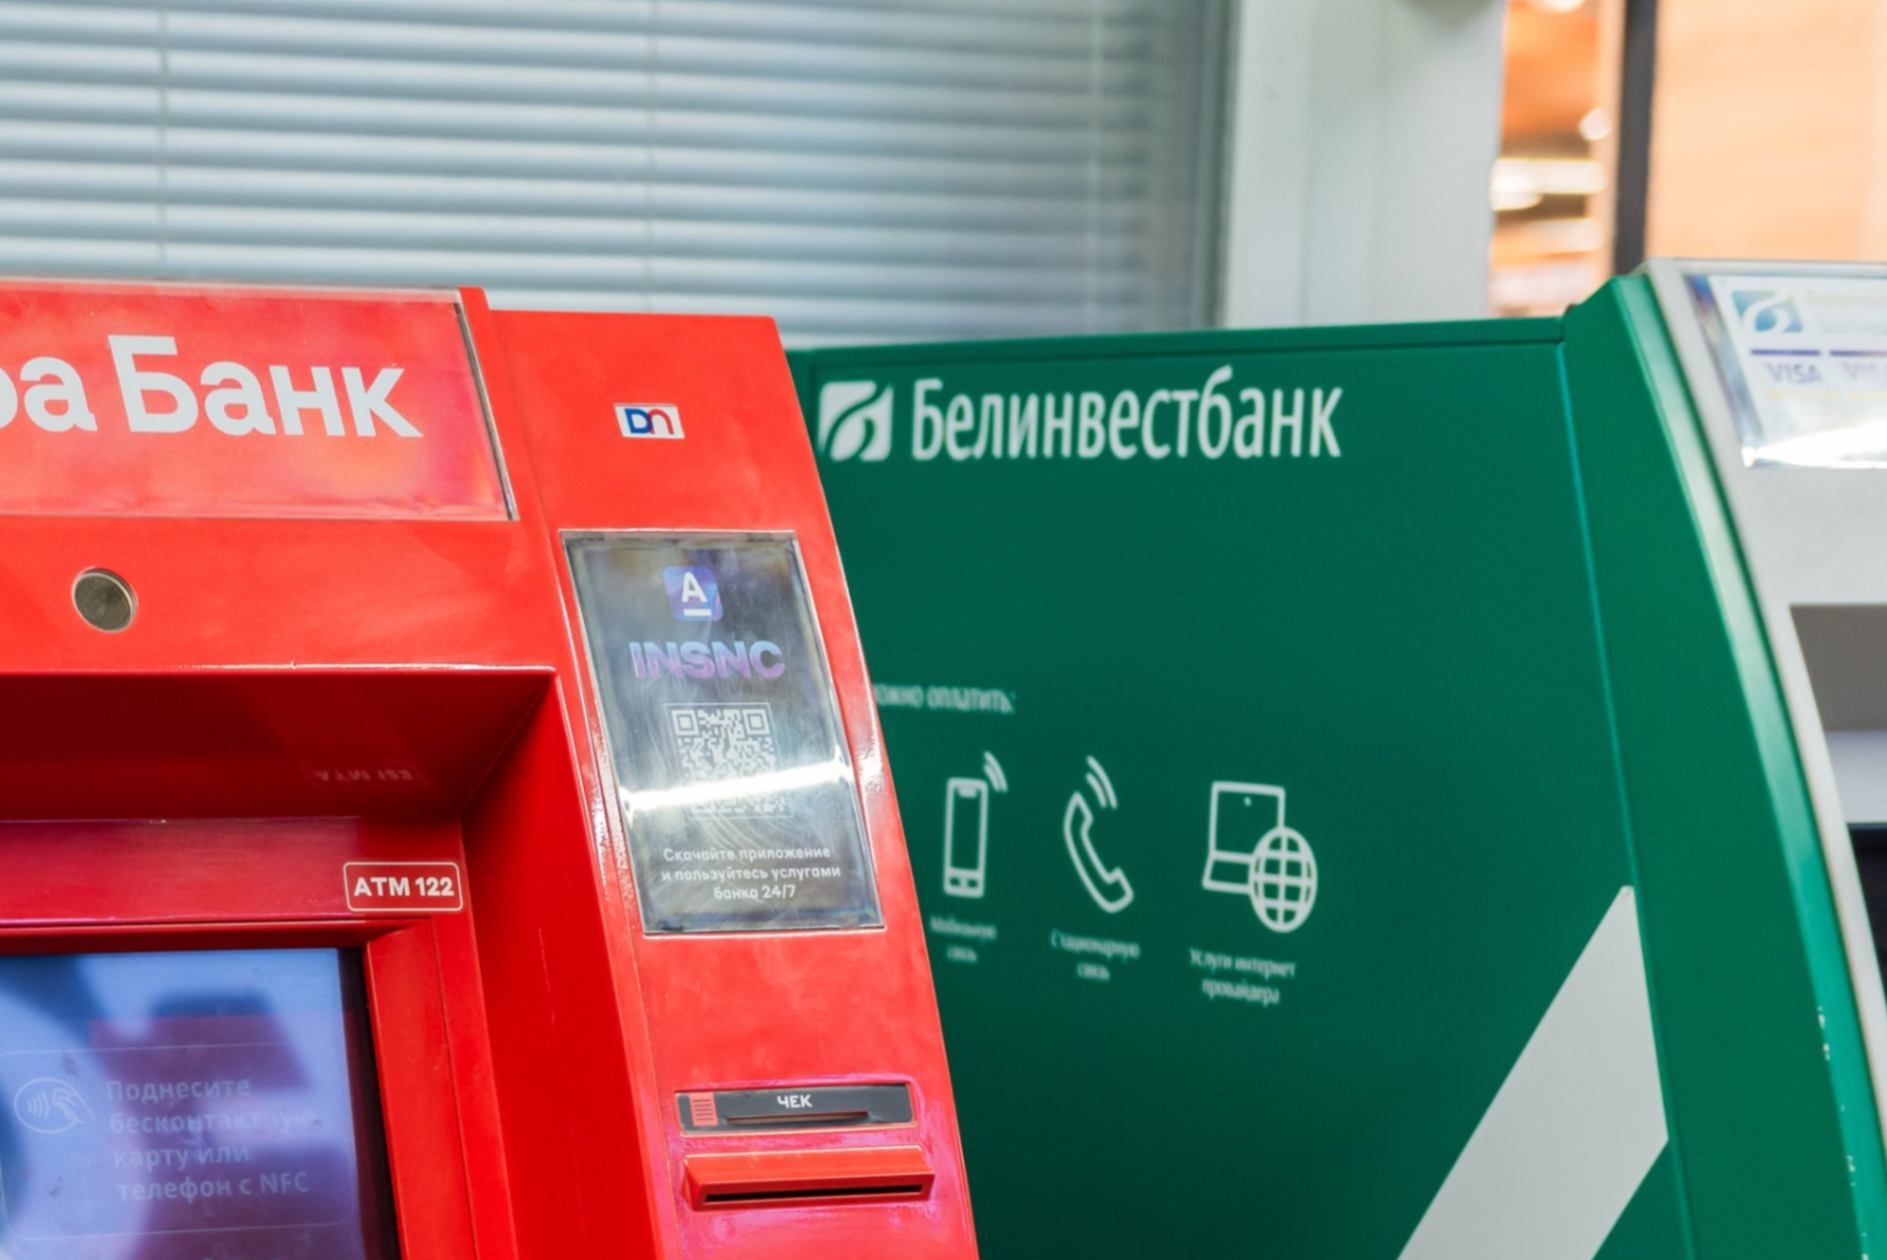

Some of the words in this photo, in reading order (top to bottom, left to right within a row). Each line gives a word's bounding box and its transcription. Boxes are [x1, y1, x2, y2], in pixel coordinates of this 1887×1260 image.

[107, 334, 424, 440] Банк
[912, 364, 1343, 462] Белинвестбанк
[628, 640, 786, 680] INSNC
[663, 847, 736, 862] Скачайте
[739, 847, 831, 863] приложение
[415, 876, 456, 897] 122
[662, 871, 672, 882] и
[675, 866, 768, 883] пользуйтесь
[771, 866, 842, 881] услугами
[713, 886, 759, 900] банка
[761, 884, 797, 899] 24/7
[105, 1077, 252, 1104] Поднесите
[776, 1093, 814, 1109] ЧЕК
[113, 1147, 189, 1171] карту
[197, 1146, 250, 1165] или
[116, 1174, 233, 1205] телефон
[239, 1178, 252, 1195] с
[258, 1171, 311, 1195] NFC
